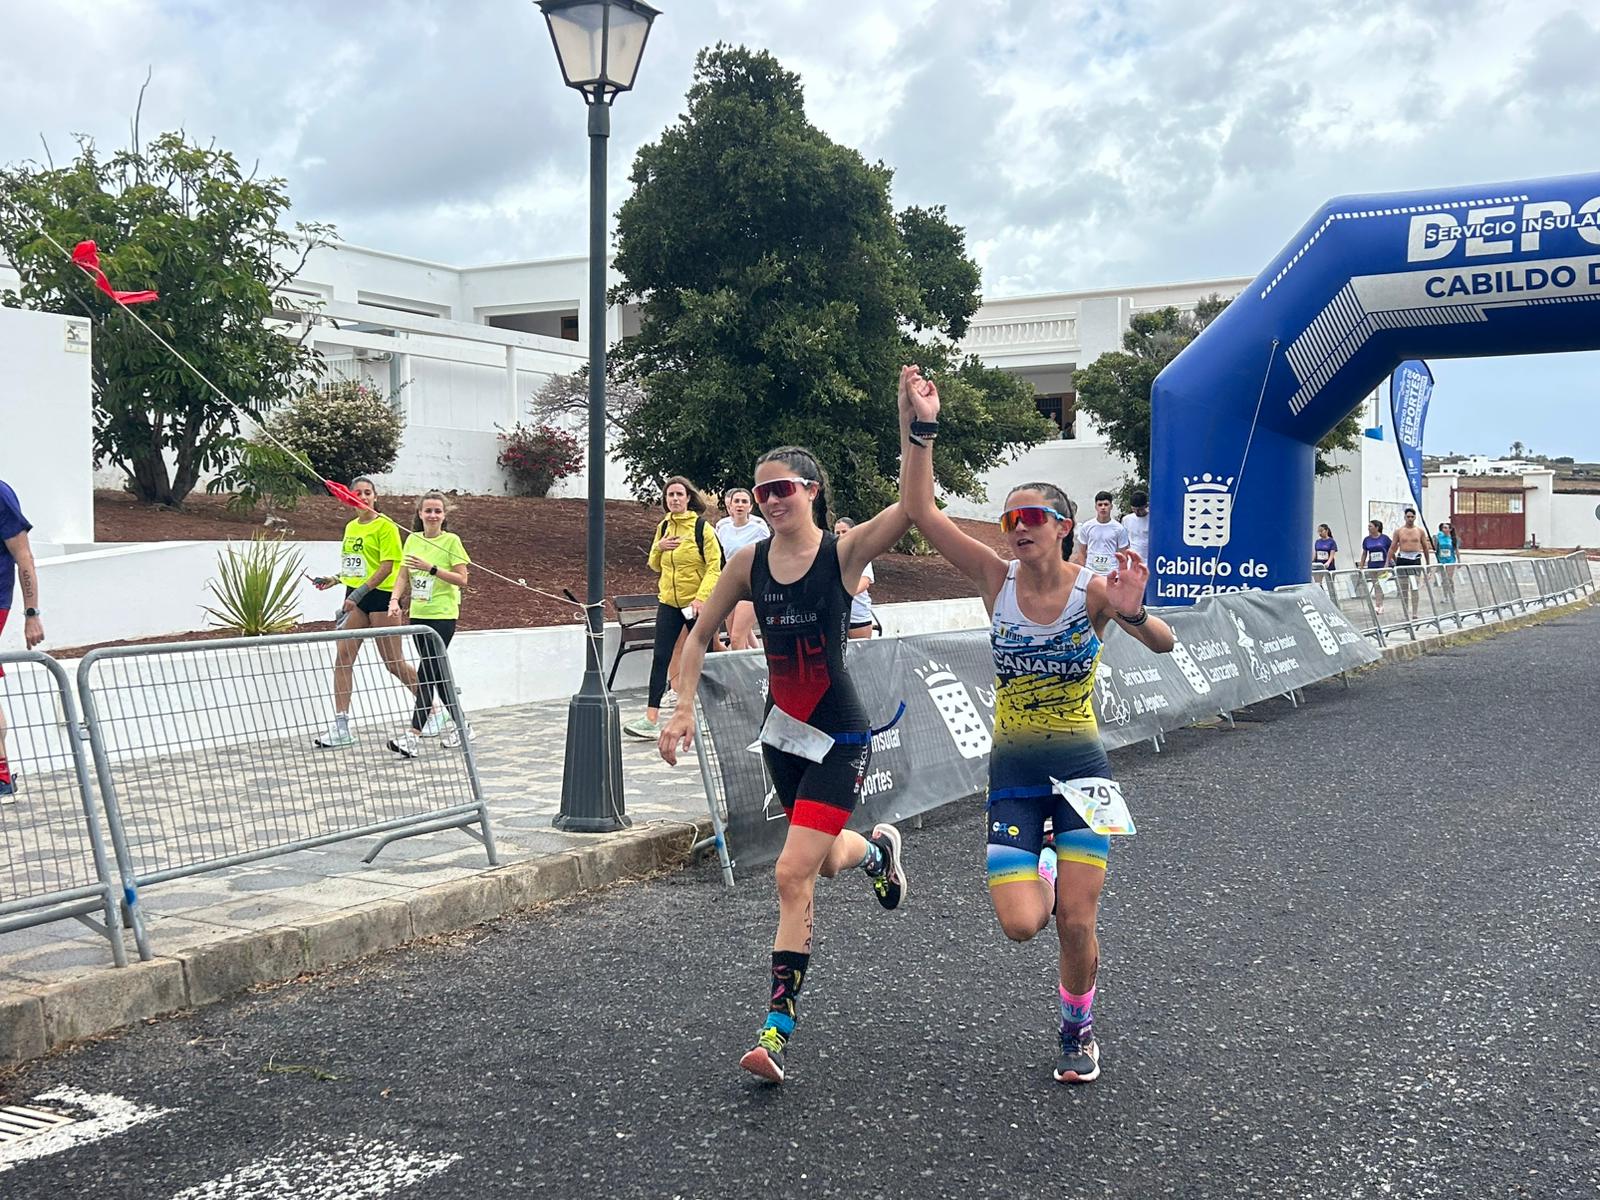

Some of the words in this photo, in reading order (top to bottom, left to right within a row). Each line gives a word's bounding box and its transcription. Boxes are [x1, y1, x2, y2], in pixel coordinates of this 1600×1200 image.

[1426, 221, 1516, 242] SERVICIO
[1425, 265, 1576, 298] CABILDO
[1404, 371, 1421, 446] DEPORTES
[346, 557, 362, 567] 379
[1095, 556, 1108, 564] 237
[1156, 556, 1232, 577] Cabildo
[1239, 559, 1268, 578] de
[1157, 578, 1262, 598] Lanzar
[765, 613, 817, 625] SPORTSCLUB
[1189, 638, 1223, 662] Cabildo
[993, 648, 1094, 675] CANARIAS
[861, 767, 893, 805] portes
